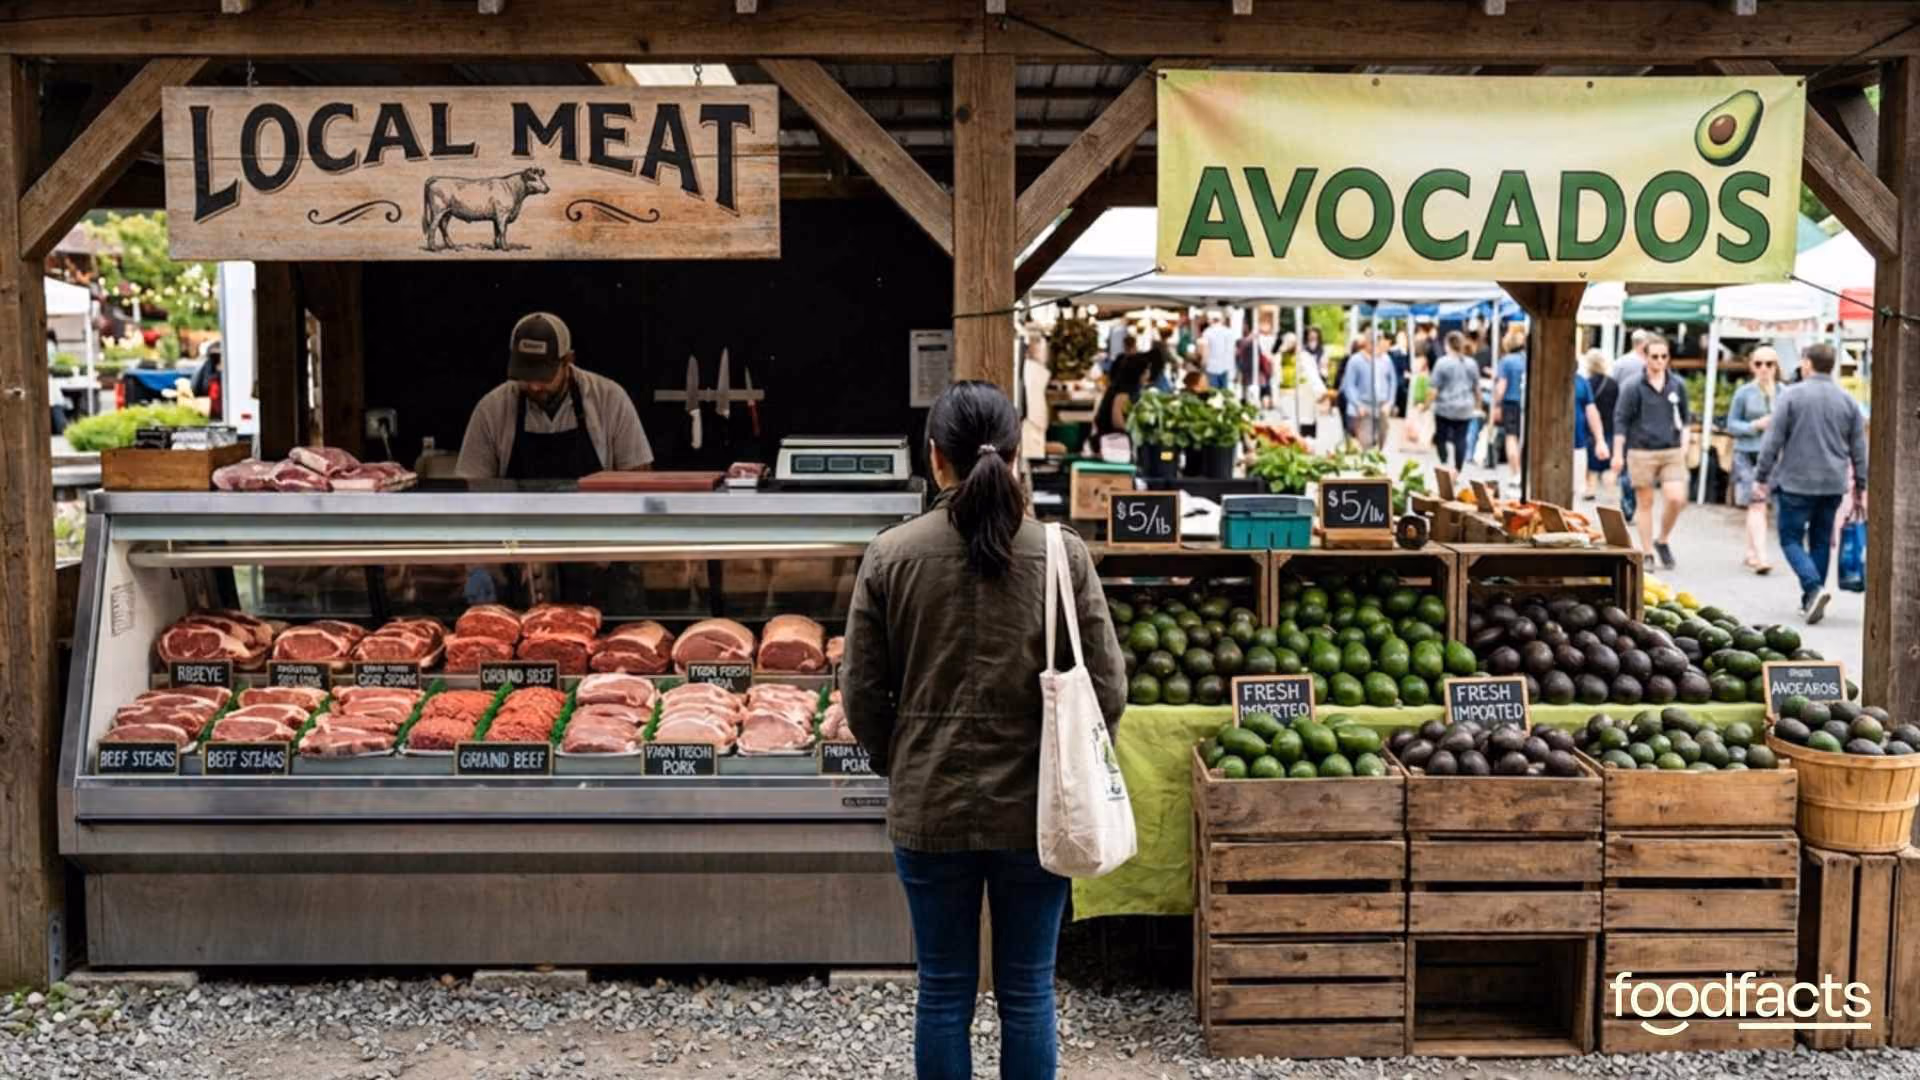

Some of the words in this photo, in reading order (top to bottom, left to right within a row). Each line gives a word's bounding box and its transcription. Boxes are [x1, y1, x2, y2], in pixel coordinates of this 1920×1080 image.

[190, 102, 478, 223] LOCAL
[511, 102, 755, 216] MEAT
[1176, 166, 1771, 264] AVOCADOS
[1243, 683, 1300, 701] FRESH
[1456, 684, 1511, 702] FRESH
[100, 751, 128, 767] BEEF
[513, 751, 546, 768] BEEF
[663, 760, 696, 775] PORK
